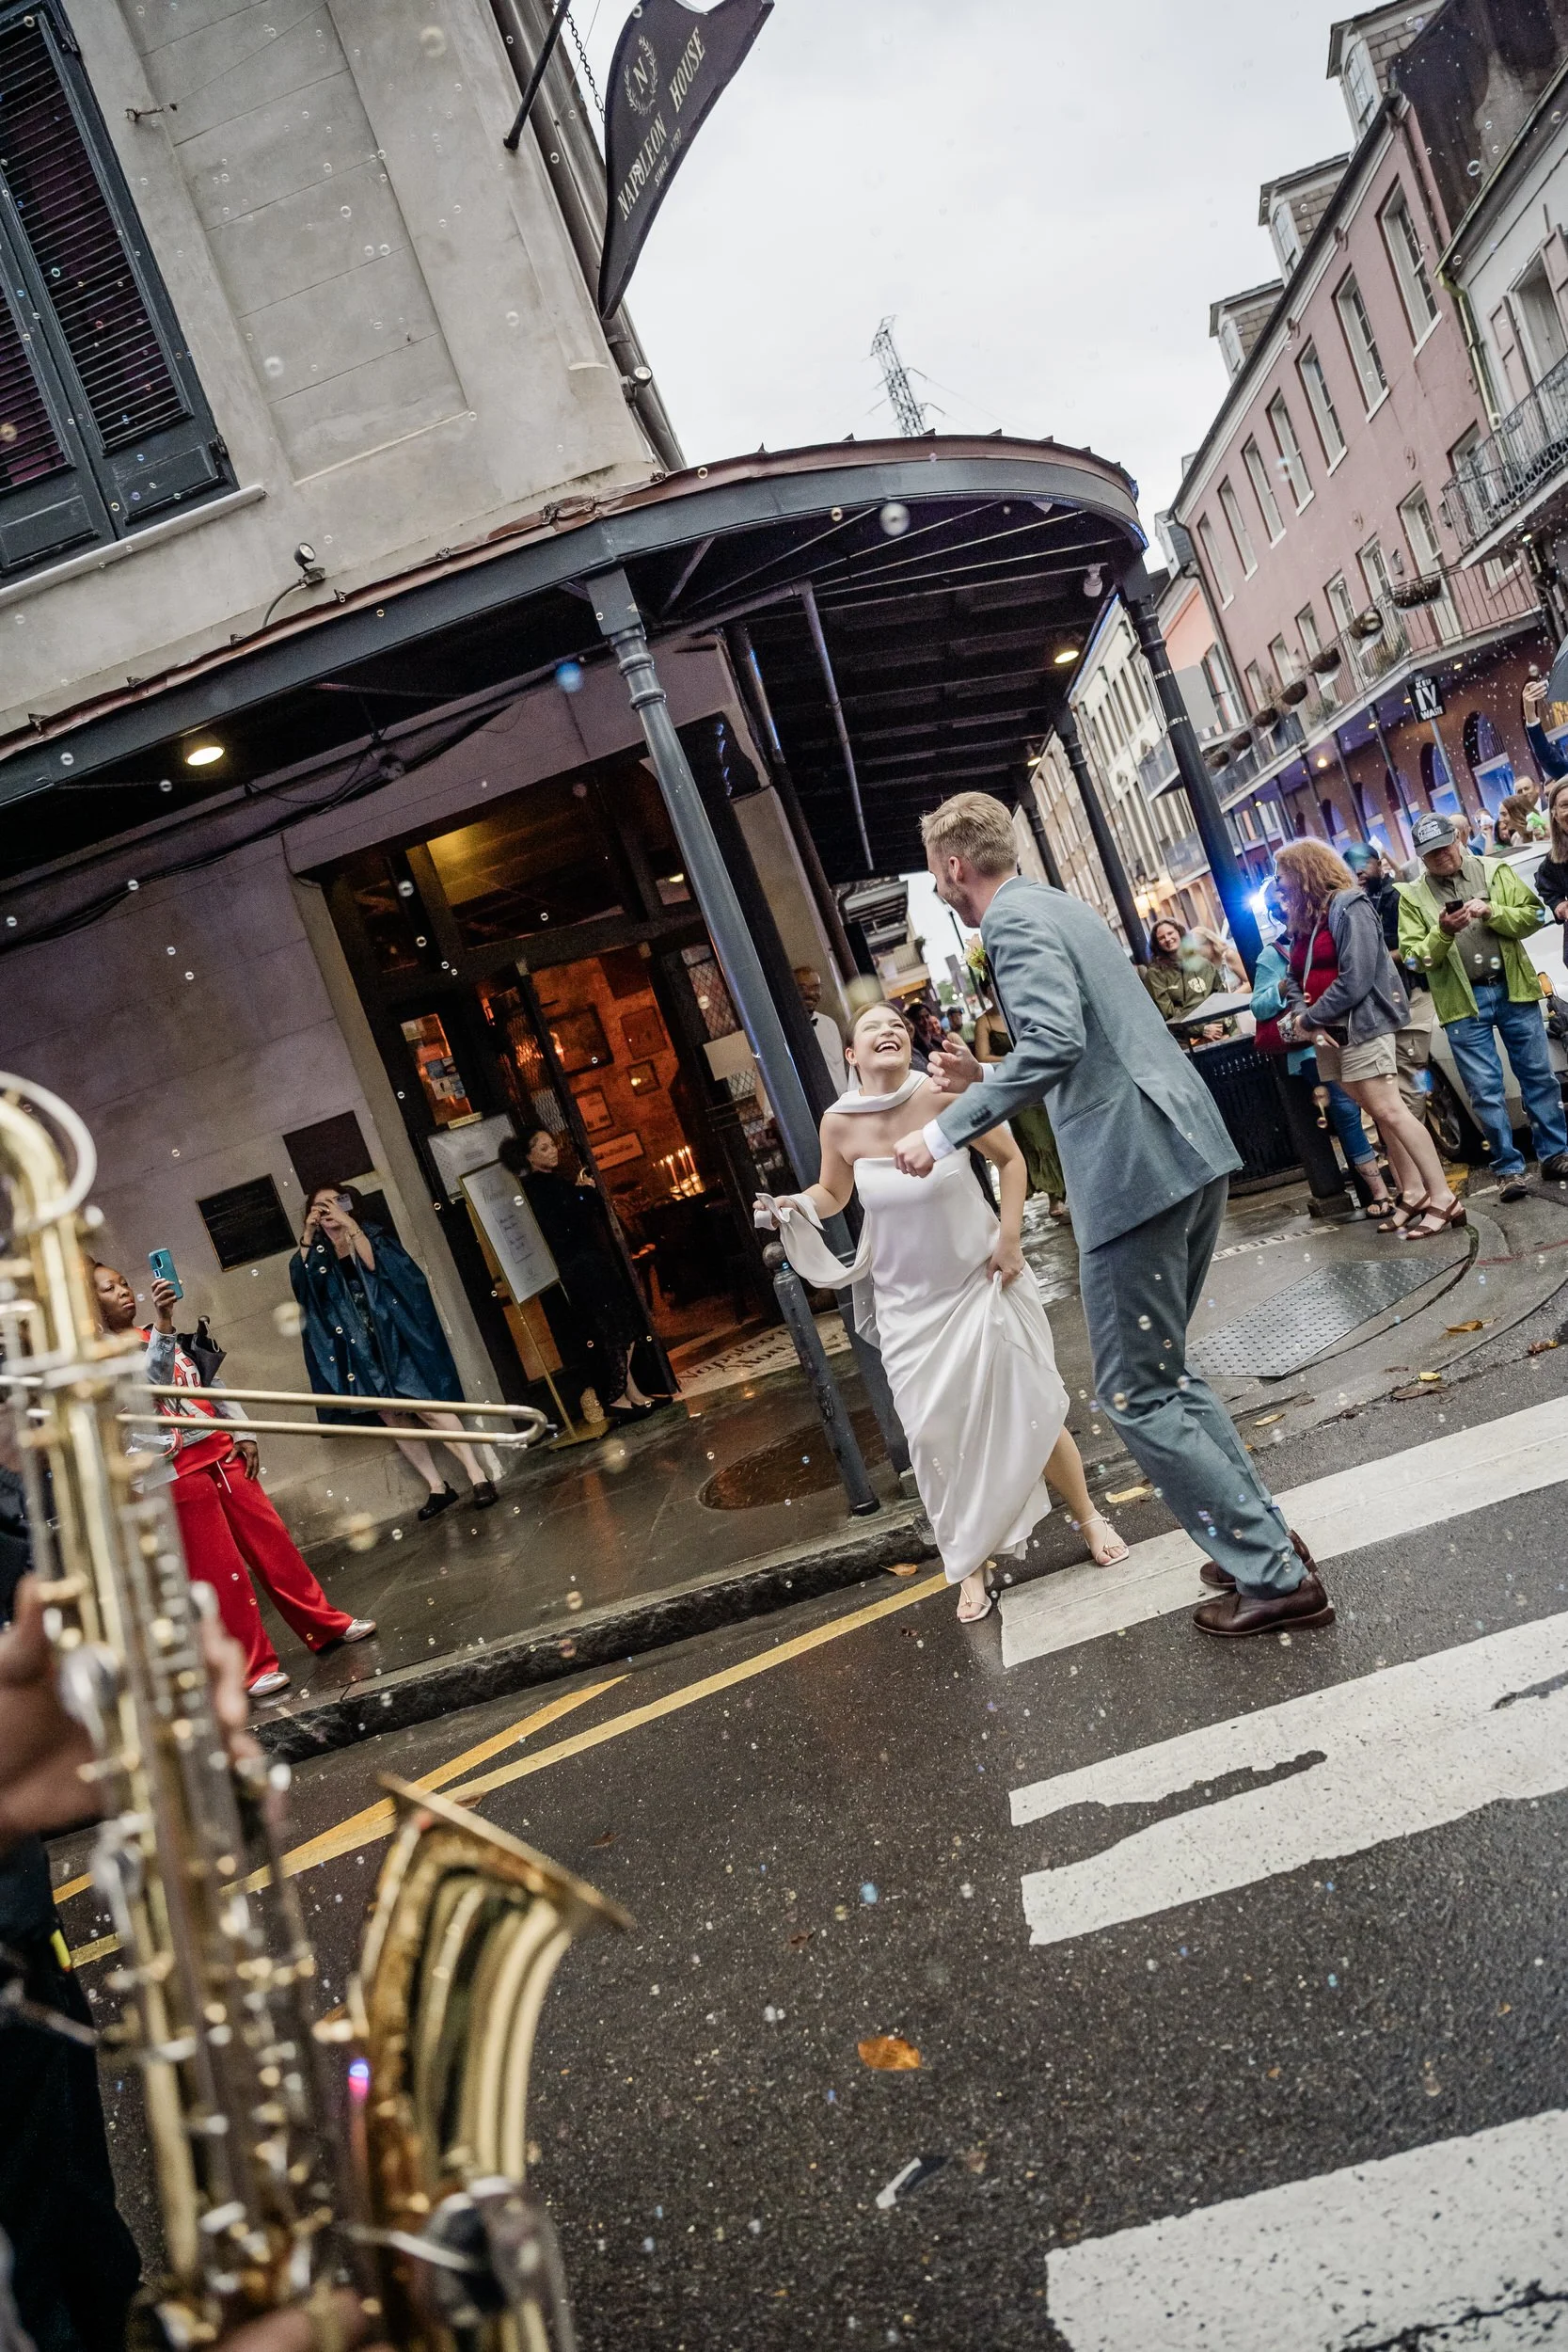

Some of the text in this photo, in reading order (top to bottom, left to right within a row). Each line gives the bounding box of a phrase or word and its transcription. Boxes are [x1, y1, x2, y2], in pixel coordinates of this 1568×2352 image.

[633, 56, 649, 94] N
[617, 26, 705, 221] NAPOLEON HOUSE
[655, 155, 669, 187] SINCE
[1415, 684, 1436, 711] IV
